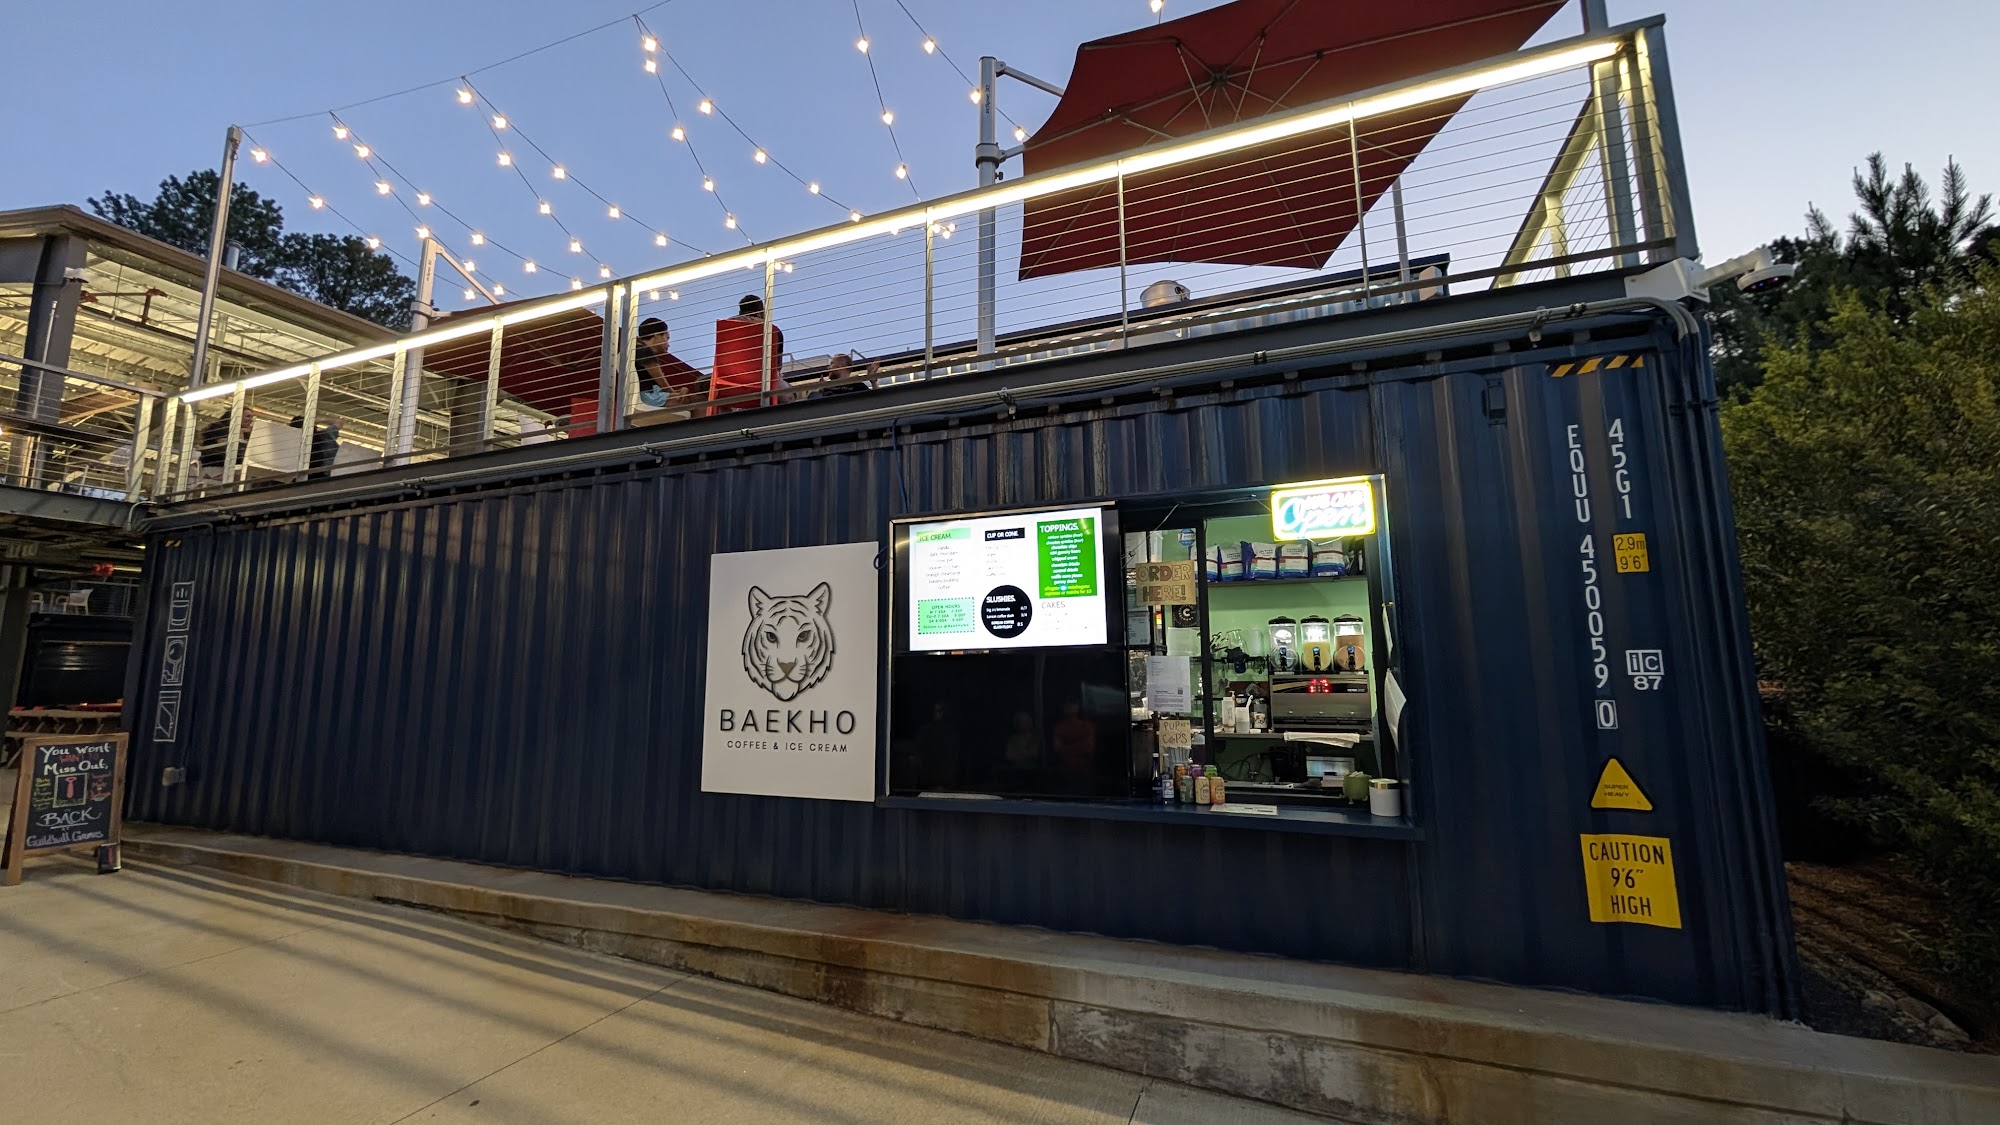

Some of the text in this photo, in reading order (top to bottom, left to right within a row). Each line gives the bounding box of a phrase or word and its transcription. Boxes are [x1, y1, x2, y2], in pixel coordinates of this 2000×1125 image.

[1609, 418, 1631, 518] 45G1
[1279, 497, 1365, 538] Open
[1040, 523, 1079, 533] TOPPINGS.
[1137, 564, 1191, 582] ORDER
[1567, 424, 1614, 727] EQUU 450059 0
[1143, 585, 1186, 602] HERE!
[1041, 601, 1066, 609] CAKES
[1634, 676, 1662, 690] 87
[720, 709, 856, 734] BAEKHO
[1164, 722, 1180, 730] PUP
[40, 746, 69, 763] You
[727, 740, 848, 752] COFFEE & ICE CREAM
[44, 764, 76, 776] Miss
[40, 807, 100, 826] BACK
[27, 830, 70, 847] Guildhall
[1590, 842, 1665, 865] CAUTION
[1611, 895, 1652, 917] HIGH
